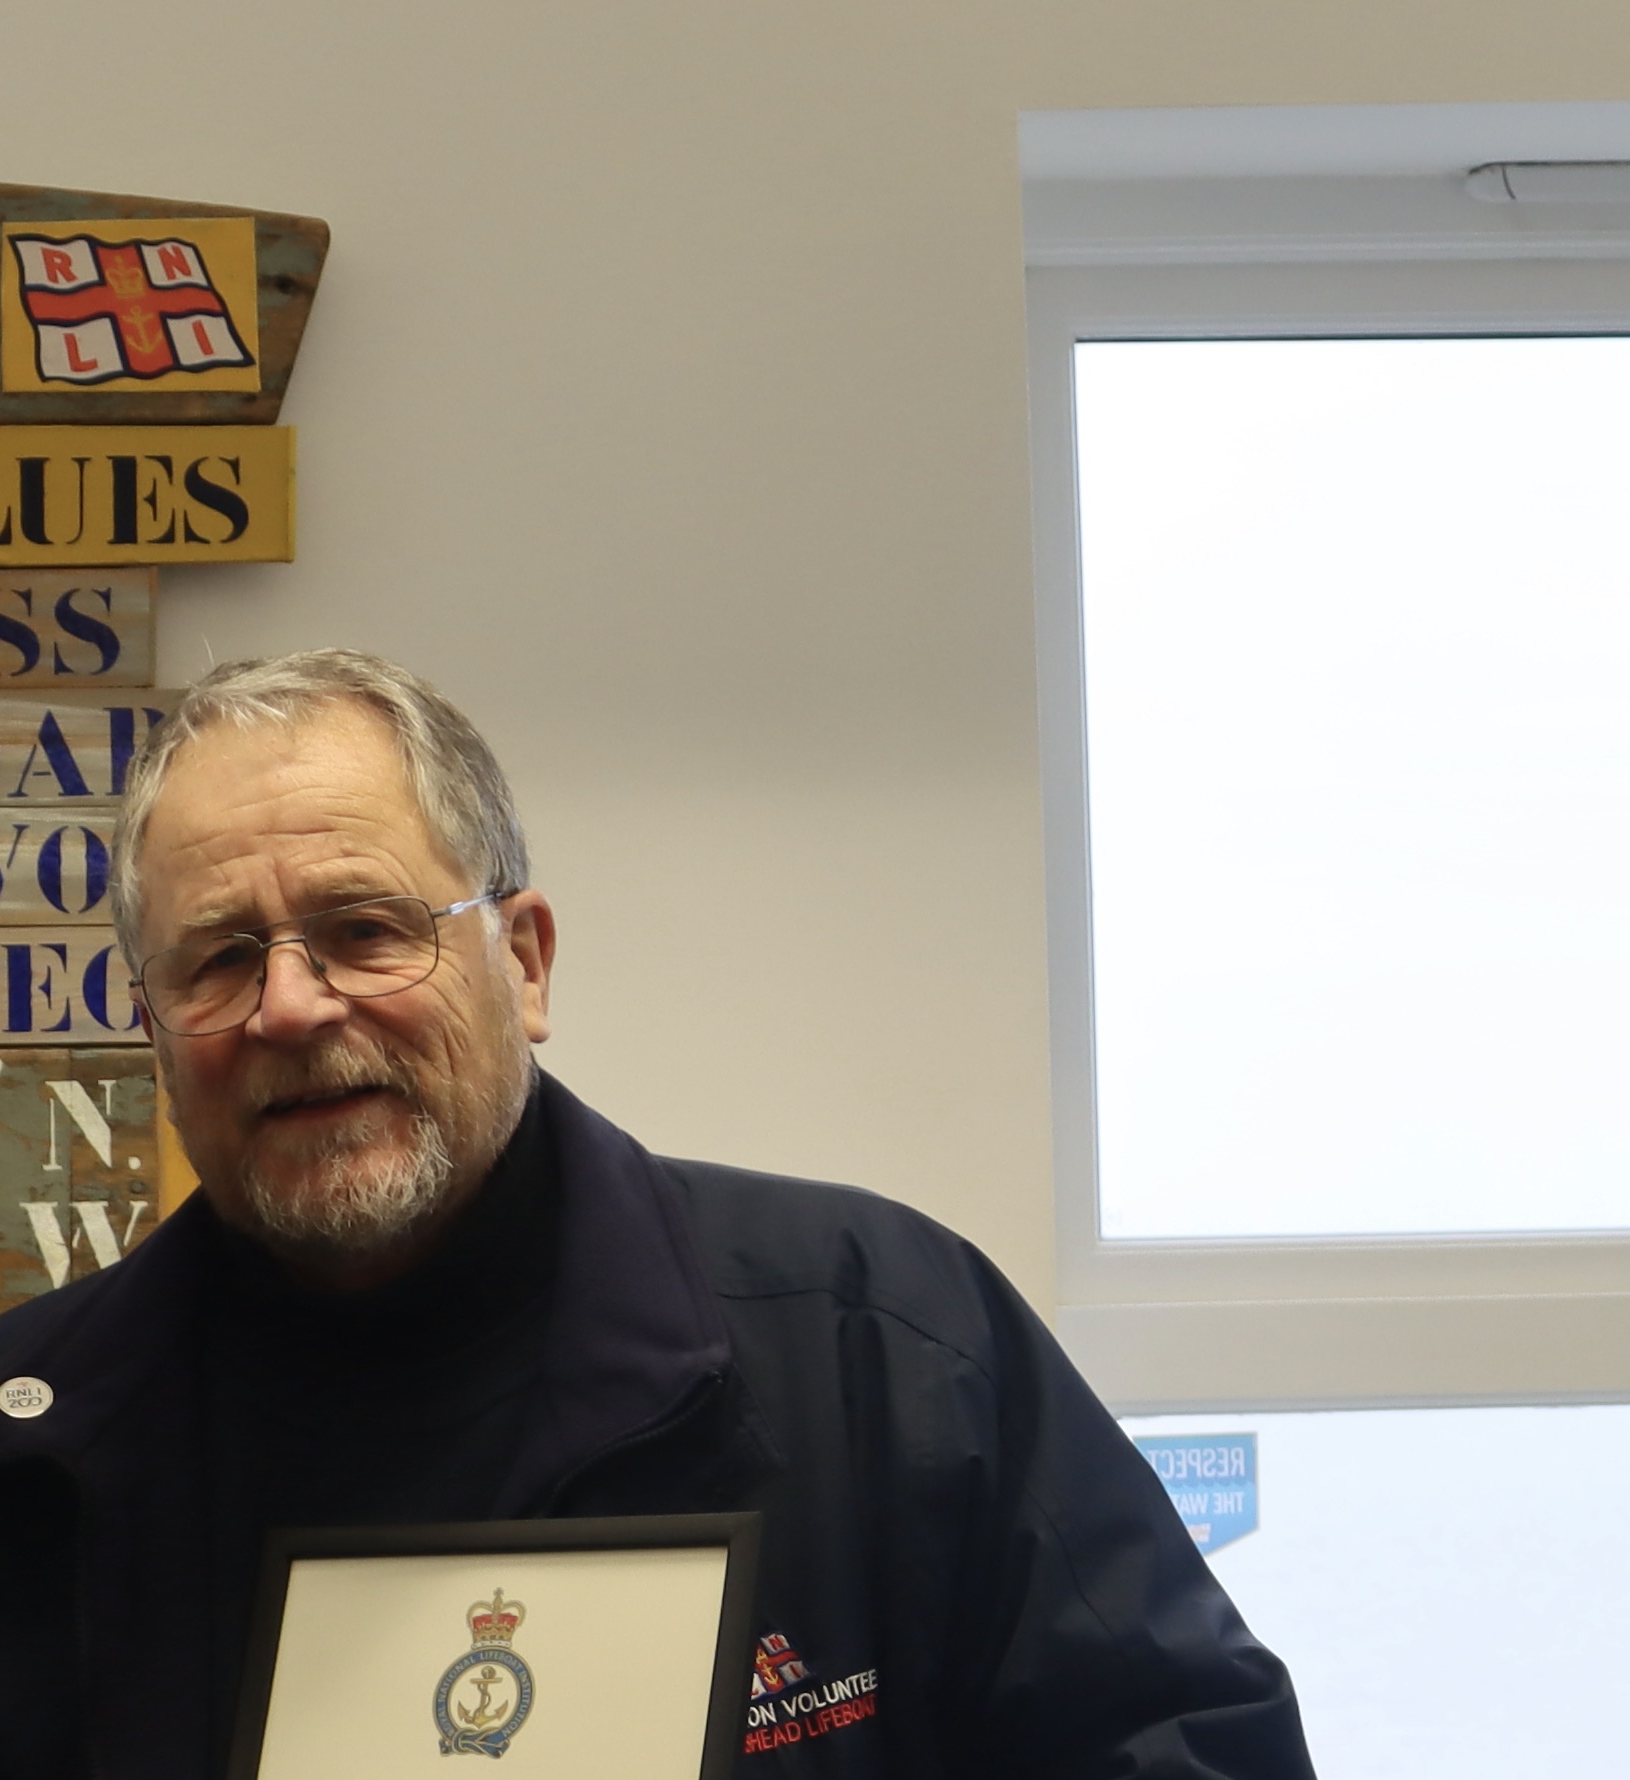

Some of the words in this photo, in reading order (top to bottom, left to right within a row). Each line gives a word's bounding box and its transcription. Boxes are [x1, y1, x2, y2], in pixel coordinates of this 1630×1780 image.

[40, 245, 78, 284] R
[156, 244, 193, 281] N
[62, 332, 99, 373] L
